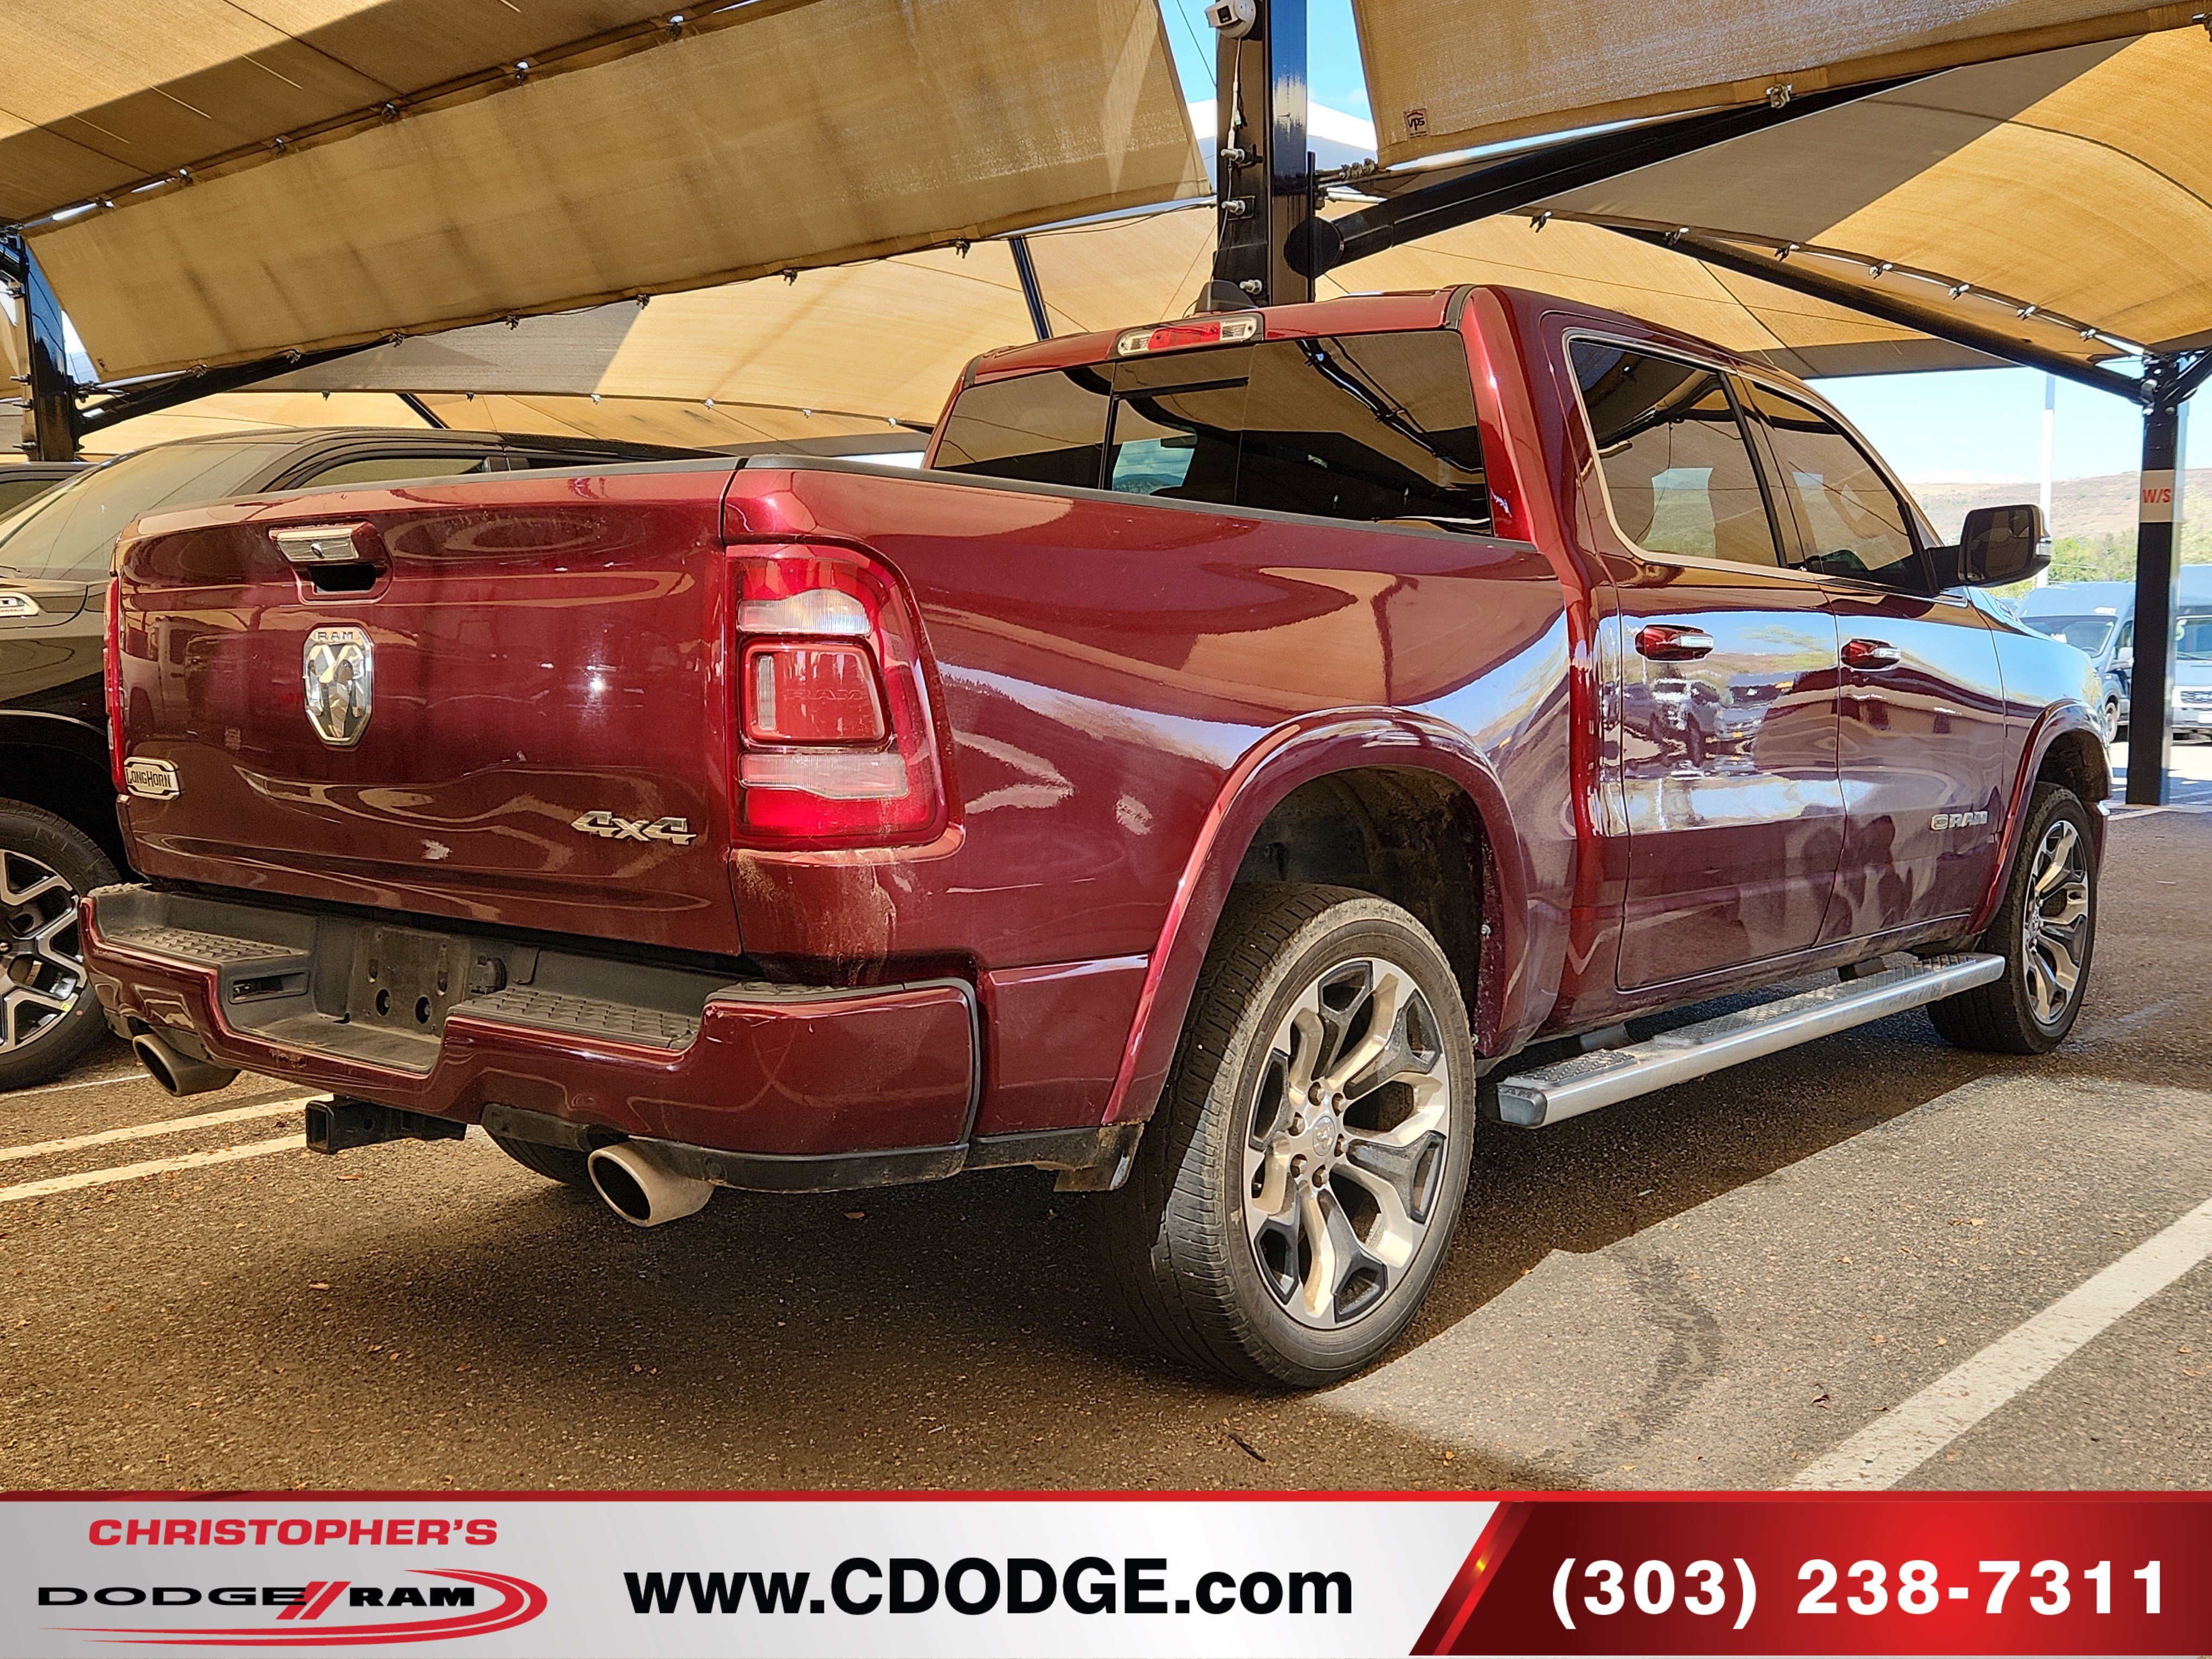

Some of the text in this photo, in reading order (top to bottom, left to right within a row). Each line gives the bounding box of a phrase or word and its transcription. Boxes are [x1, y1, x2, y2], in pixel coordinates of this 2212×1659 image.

[2143, 488, 2171, 503] W/S
[315, 631, 353, 642] RAM
[784, 689, 863, 700] RAM
